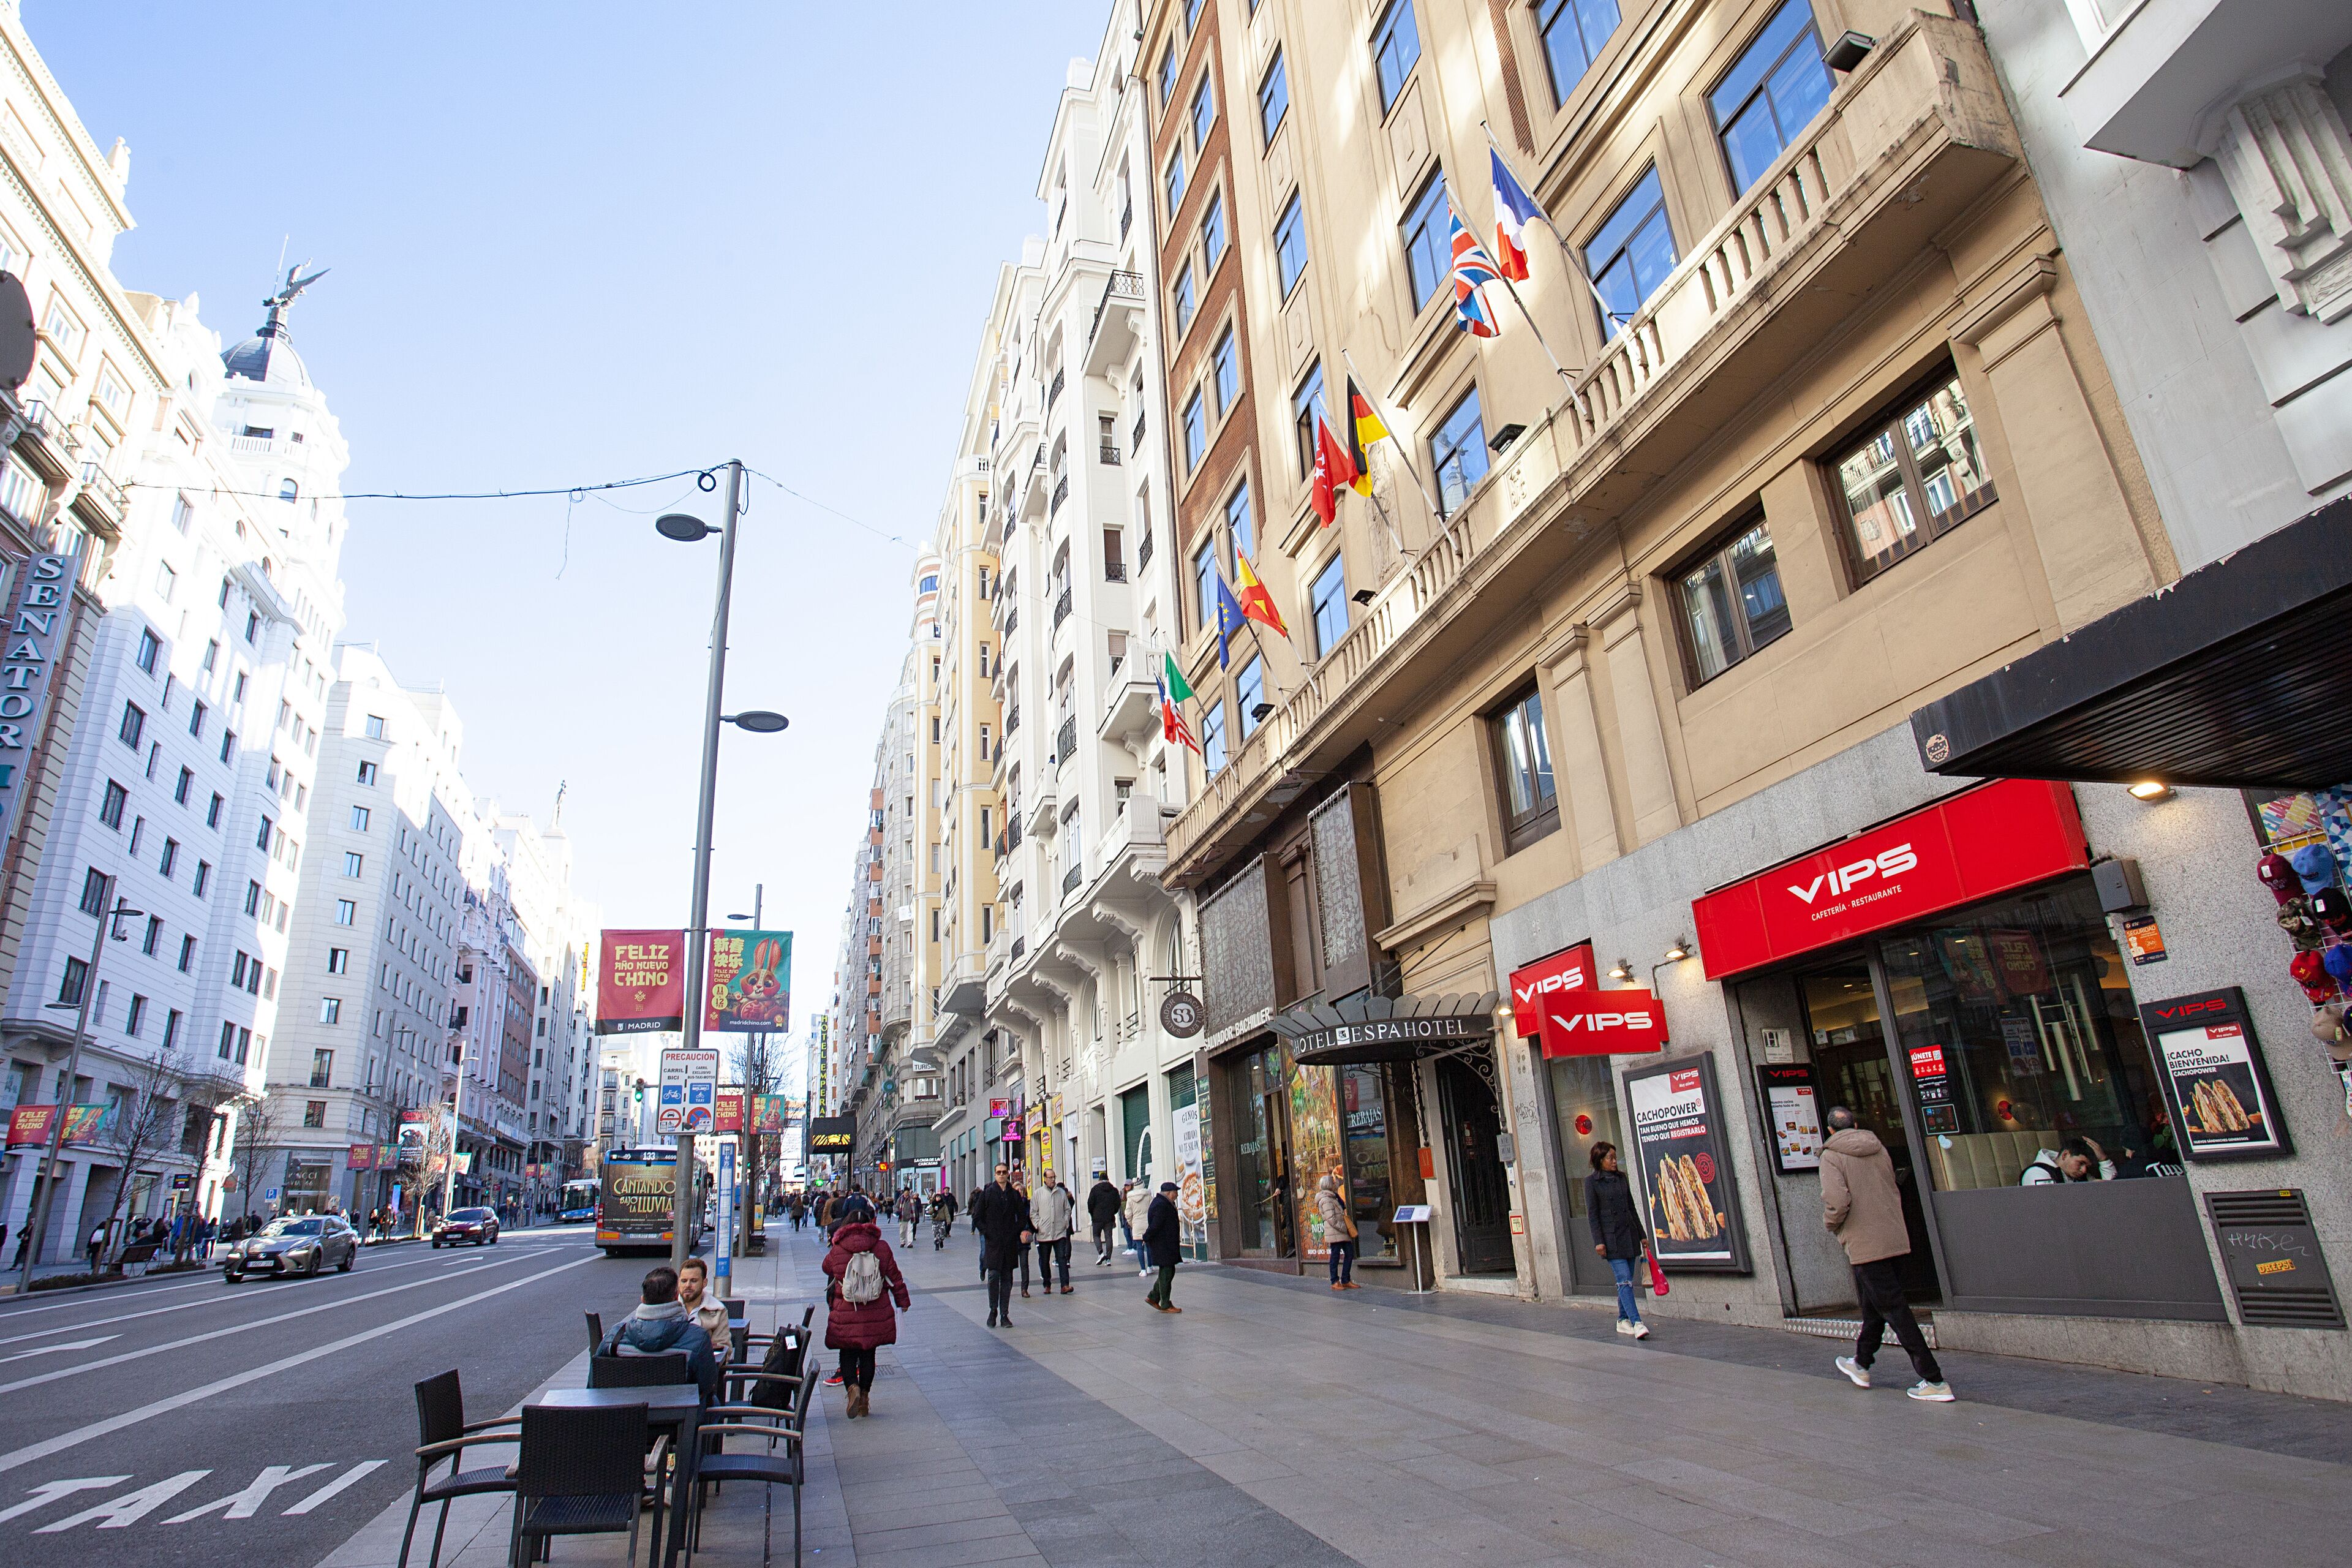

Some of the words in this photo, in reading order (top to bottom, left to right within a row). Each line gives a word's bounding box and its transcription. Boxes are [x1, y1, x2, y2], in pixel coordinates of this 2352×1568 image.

[0, 556, 66, 748] SENATOR
[1787, 843, 1917, 904] VIPS
[1811, 900, 1847, 921] CAFETERÍA
[1851, 884, 1902, 907] RESTAURANTE
[2127, 925, 2156, 937] SEGURIDAD
[615, 944, 669, 960] FELIZ
[713, 937, 745, 953] 新春
[615, 960, 634, 970] AÑO
[636, 961, 669, 971] NUEVO
[713, 953, 744, 968] 快乐
[614, 971, 668, 987] CHINO
[1515, 967, 1584, 1004] VIPS
[1183, 995, 1204, 1033] BACHILLER
[2156, 998, 2226, 1018] VIPS
[1164, 999, 1181, 1035] SALVADOR
[1550, 1011, 1653, 1032] VIPS
[1204, 1025, 1234, 1052] SALVADOR
[1235, 1006, 1273, 1038] BACHILLER
[1294, 1030, 1335, 1054] HOTEL
[666, 1052, 715, 1061] PRECAUCIÓN
[2166, 1048, 2203, 1061] ¡CACHO
[2169, 1054, 2230, 1069] BIENVENIDA!
[1672, 1069, 1698, 1081] VIPS
[1768, 1069, 1809, 1078] VIPS
[2173, 1066, 2217, 1077] CACHOPOWER
[1182, 1110, 1197, 1123] GINOS
[1351, 1107, 1382, 1126] REBAJAS
[1650, 1123, 1667, 1133] BUENO
[1679, 1117, 1699, 1127] HEMOS
[1642, 1134, 1659, 1143] TENIDO
[1670, 1125, 1706, 1138] REGISTRARLO
[1240, 1140, 1261, 1156] REBAJAS
[614, 1178, 676, 1194] CANTANDO
[620, 1196, 638, 1206] BAJO
[638, 1196, 673, 1213] LLUVIA
[0, 1459, 390, 1534] TAXI
